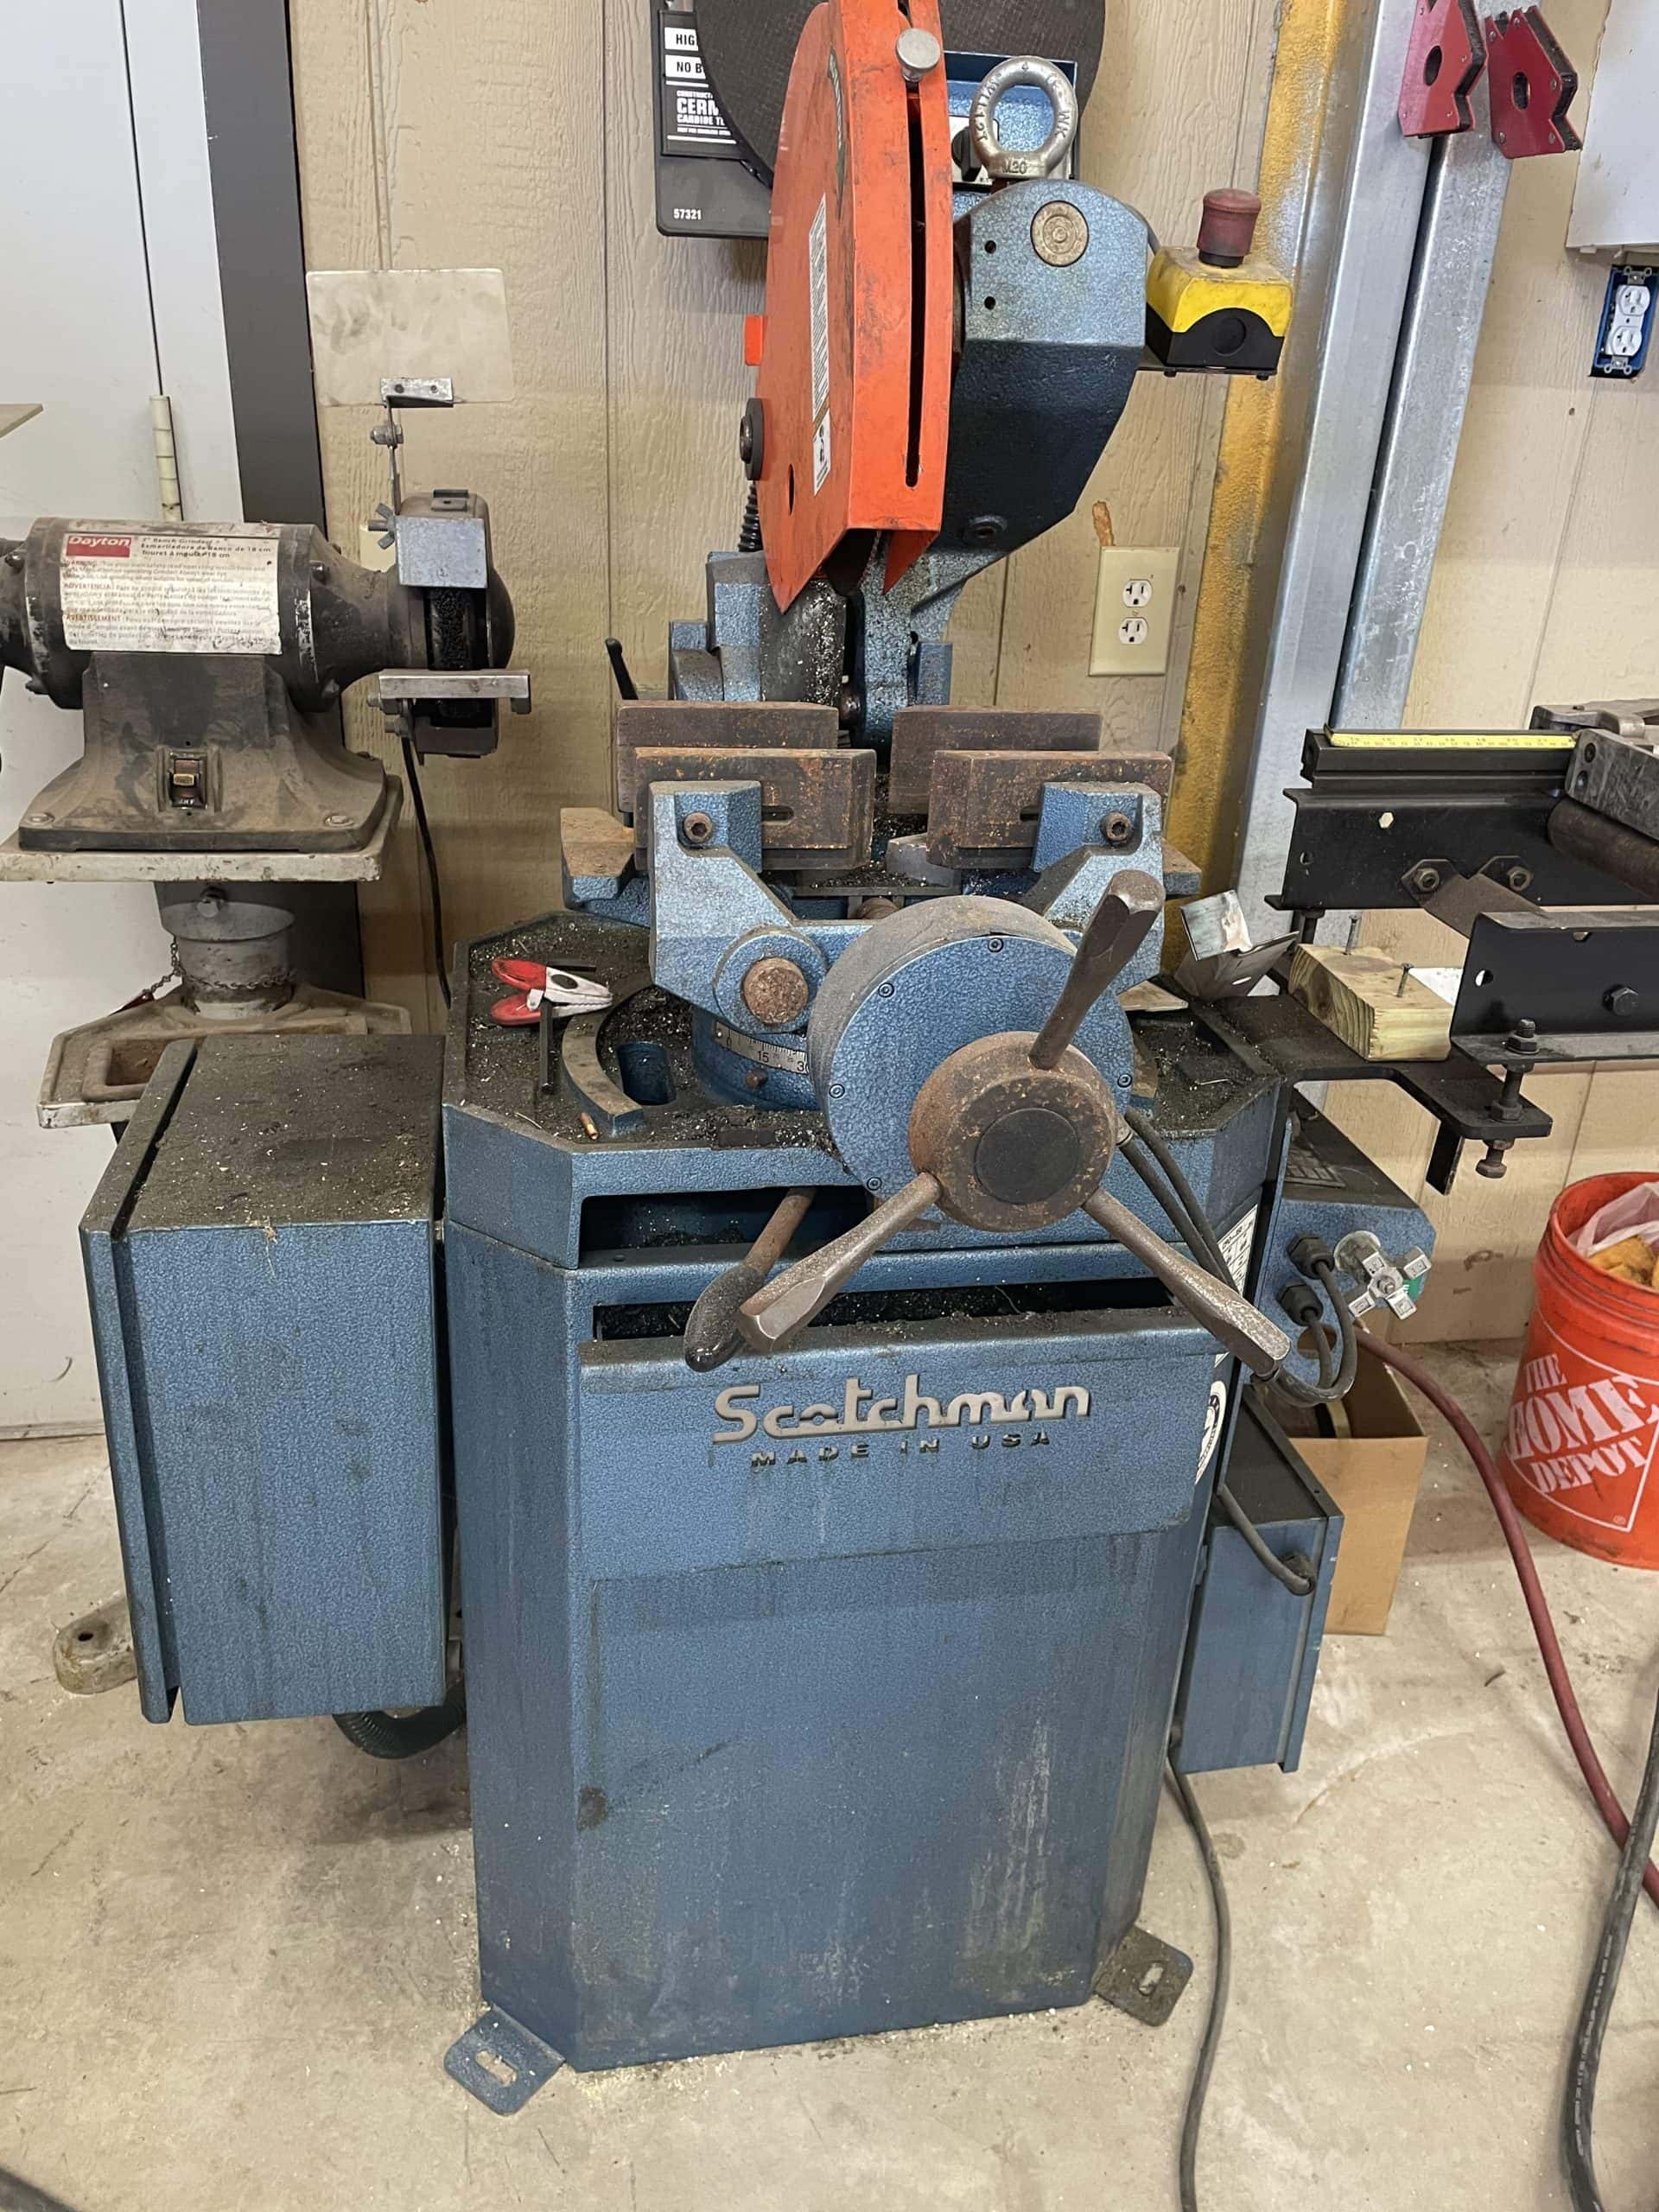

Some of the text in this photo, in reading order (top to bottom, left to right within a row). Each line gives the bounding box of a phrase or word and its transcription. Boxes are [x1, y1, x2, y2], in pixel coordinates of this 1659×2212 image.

[676, 34, 696, 45] HIG
[677, 61, 702, 73] NO B
[677, 98, 720, 116] CERM
[677, 113, 714, 126] CARBIDE
[673, 207, 702, 220] 57321
[68, 536, 130, 548] Dayton
[758, 1050, 769, 1063] 15
[1525, 1354, 1568, 1393] THE
[712, 1373, 1090, 1444] Scotchman
[1509, 1375, 1659, 1460] HOME
[751, 1430, 1050, 1467] MADE IN USA
[1530, 1436, 1647, 1494] DEPOT
